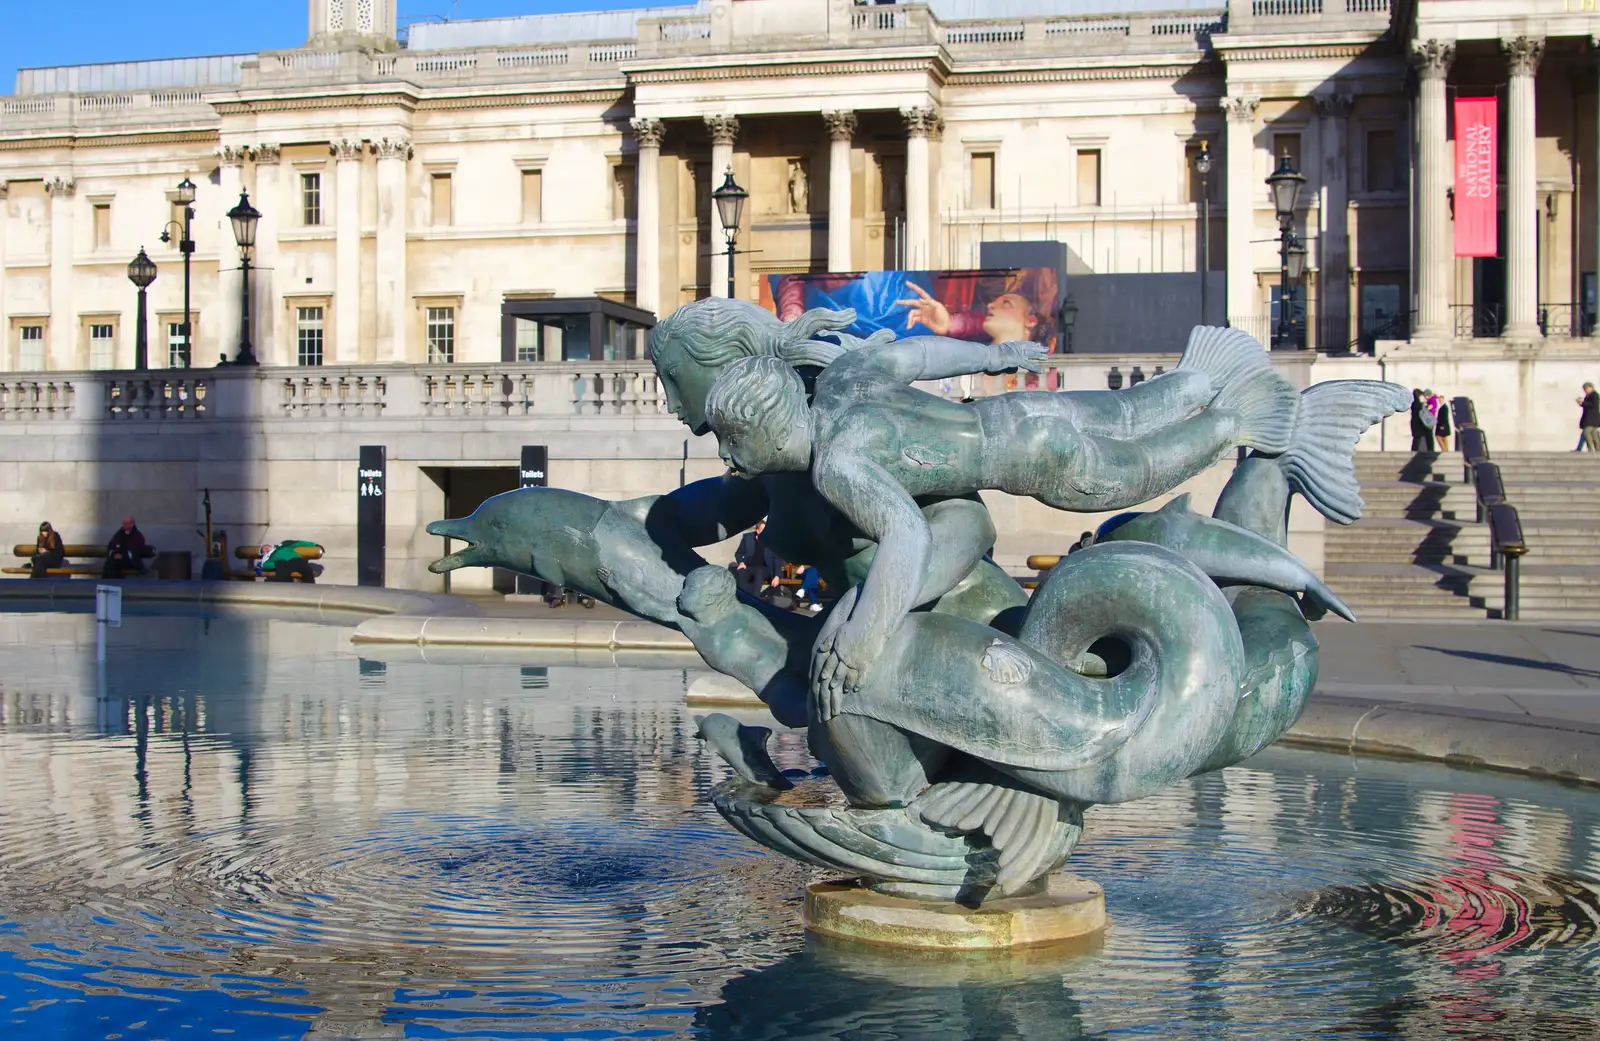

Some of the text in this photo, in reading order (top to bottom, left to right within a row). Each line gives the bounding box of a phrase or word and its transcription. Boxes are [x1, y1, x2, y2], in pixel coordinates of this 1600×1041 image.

[1466, 124, 1477, 197] NATIONAL
[1478, 124, 1491, 198] GALLERY
[360, 469, 382, 478] Toilets
[521, 470, 544, 478] Toilets
